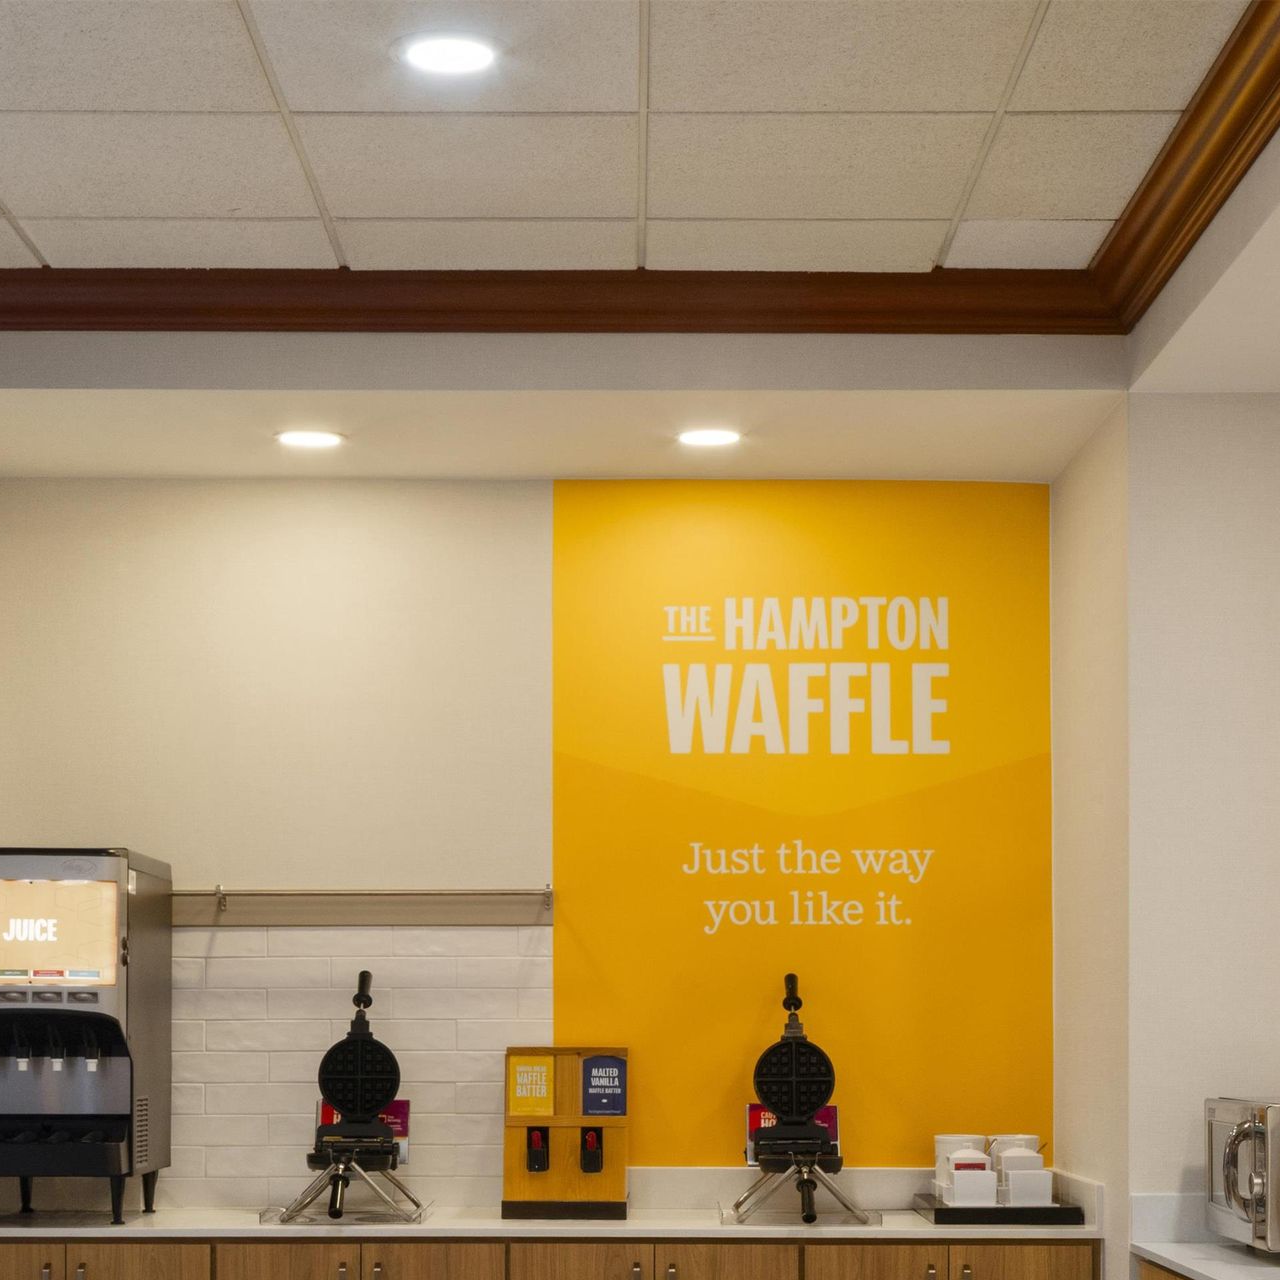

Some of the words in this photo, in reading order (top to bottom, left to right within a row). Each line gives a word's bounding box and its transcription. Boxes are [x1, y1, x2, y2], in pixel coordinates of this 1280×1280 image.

[663, 606, 711, 633] THE
[724, 596, 949, 650] HAMPTON
[662, 662, 950, 754] WAFFLE
[682, 842, 766, 874] Just
[776, 840, 841, 874] the
[851, 849, 934, 884] way
[703, 899, 777, 934] you
[789, 891, 864, 925] like
[875, 892, 912, 925] it.
[3, 918, 57, 941] JUICE
[517, 1072, 547, 1085] WAFFLE
[591, 1077, 619, 1086] VANILLA
[592, 1068, 618, 1077] MALTED
[516, 1085, 547, 1097] BATTER
[761, 1119, 777, 1128] HO
